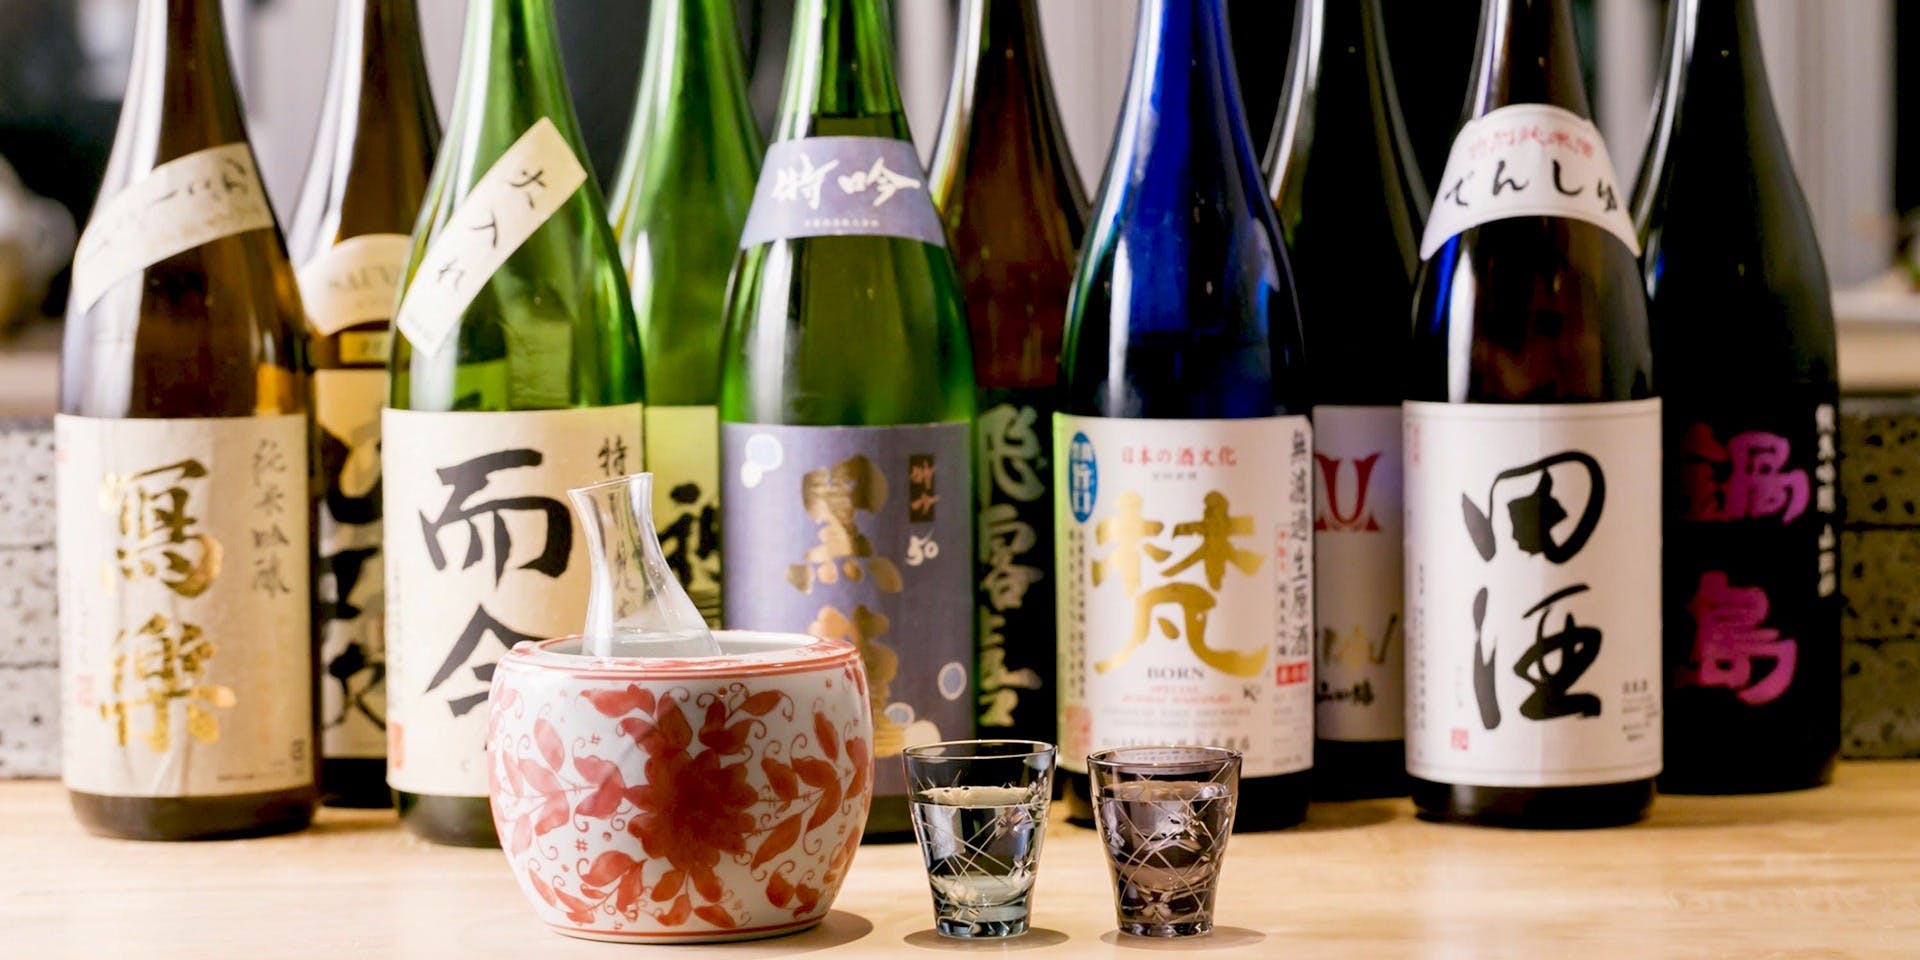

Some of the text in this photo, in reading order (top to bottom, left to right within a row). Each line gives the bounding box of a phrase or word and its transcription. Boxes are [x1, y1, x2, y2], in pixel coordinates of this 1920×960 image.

[772, 152, 921, 210] 特吟
[1445, 158, 1619, 212] でんしゅ
[437, 169, 546, 292] 火入れ
[1121, 445, 1238, 467] 日本の酒文化
[905, 531, 939, 566] 50
[1679, 422, 1812, 706] 鍋島
[1092, 490, 1269, 677] 梵
[1461, 449, 1607, 731] 田酒
[1147, 666, 1205, 680] BORN
